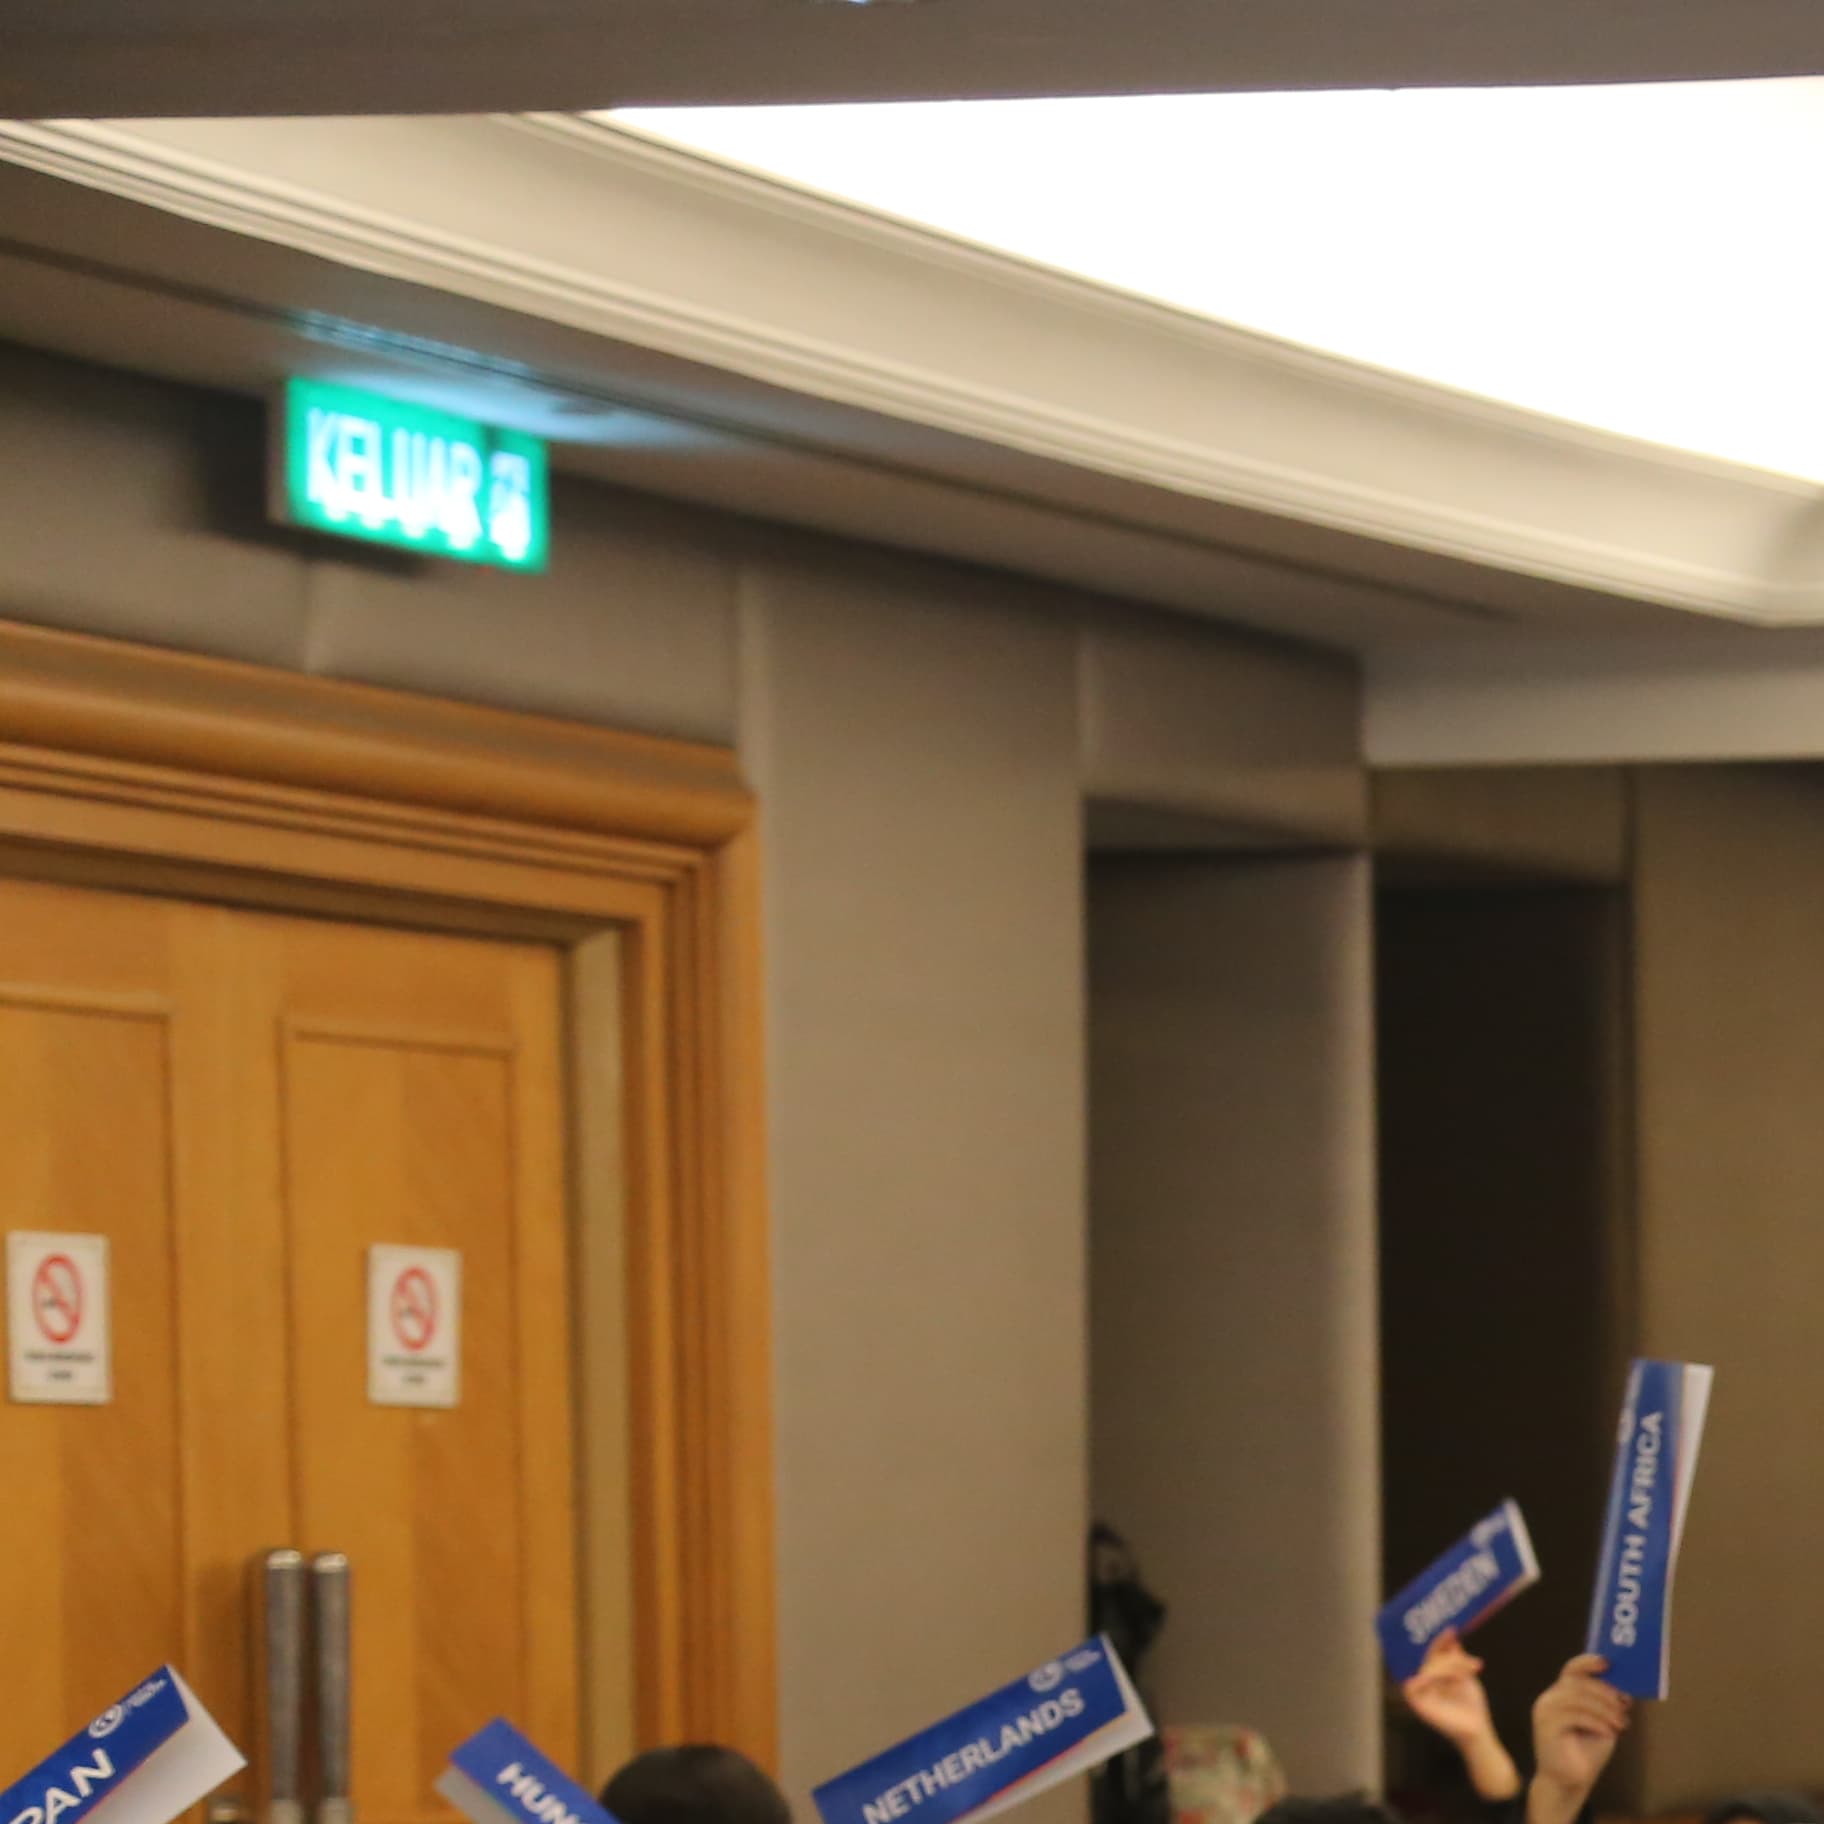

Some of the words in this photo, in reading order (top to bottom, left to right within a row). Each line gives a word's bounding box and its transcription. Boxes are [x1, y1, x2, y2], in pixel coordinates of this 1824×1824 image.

[306, 406, 483, 550] KELUAR
[1627, 1411, 1665, 1529] AFRICA
[1610, 1534, 1647, 1648] SOUTH
